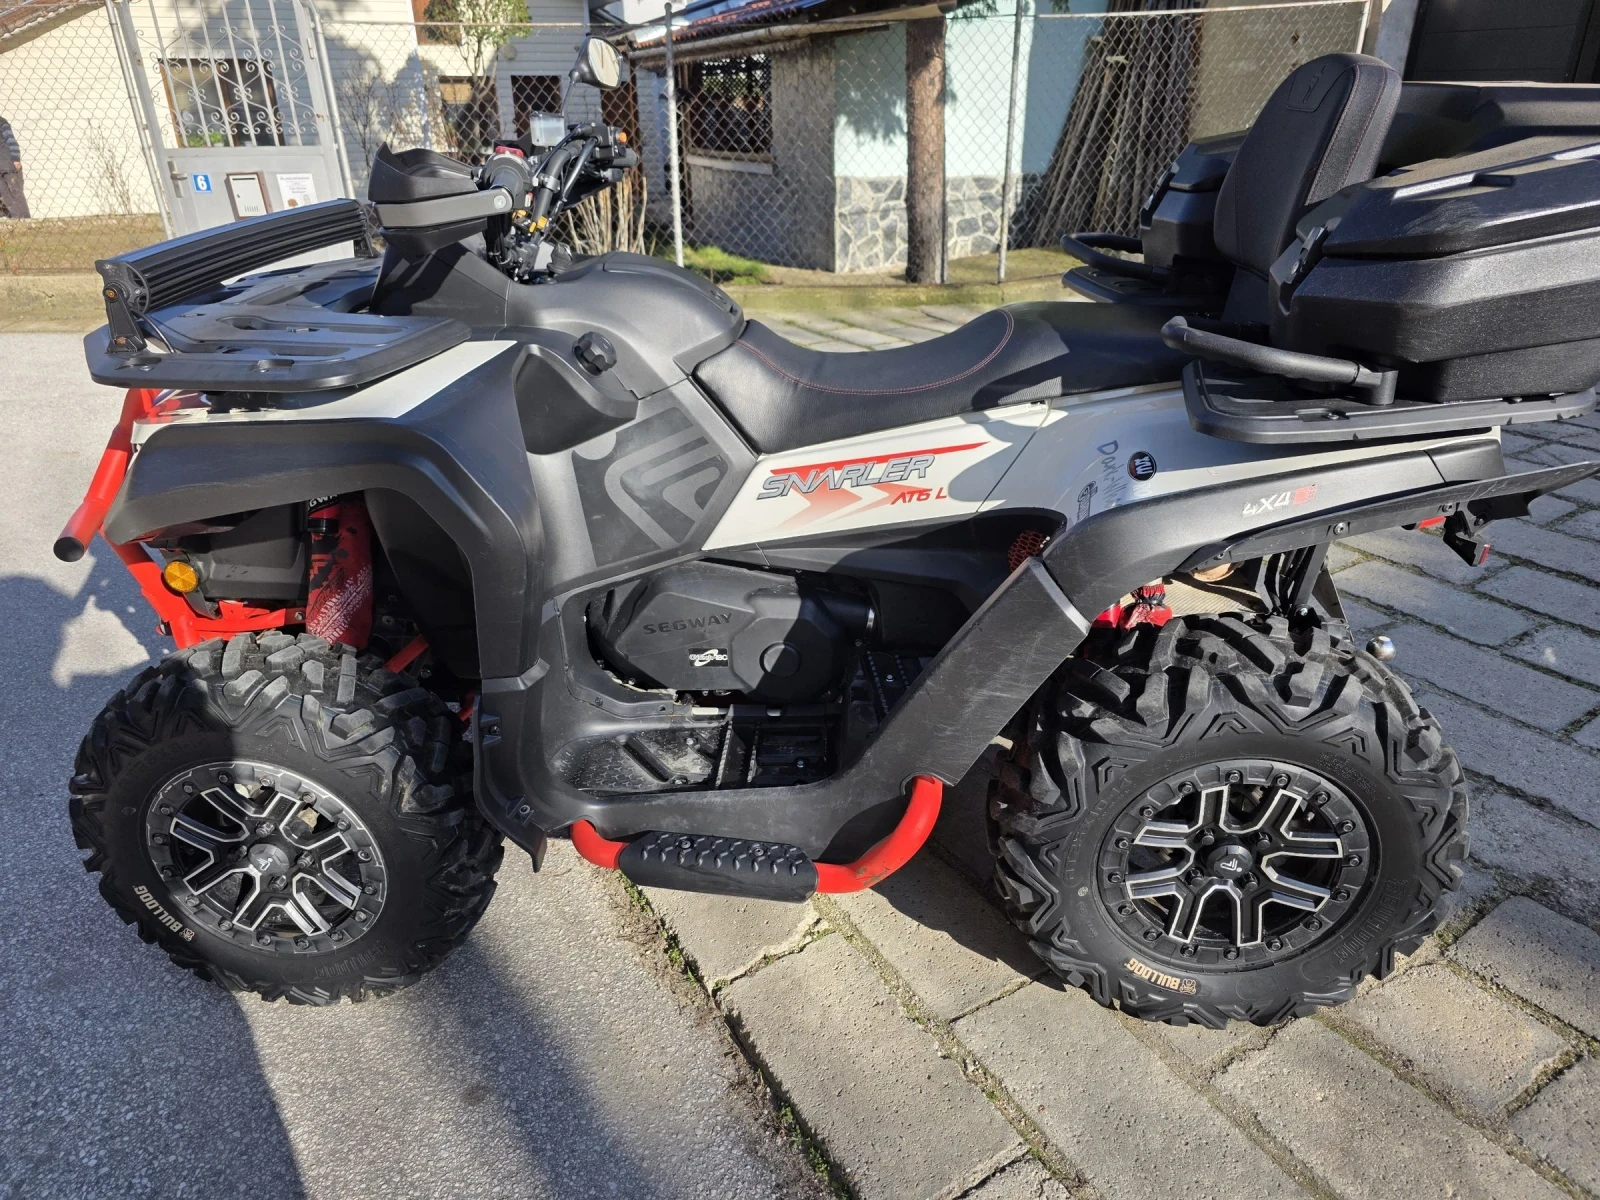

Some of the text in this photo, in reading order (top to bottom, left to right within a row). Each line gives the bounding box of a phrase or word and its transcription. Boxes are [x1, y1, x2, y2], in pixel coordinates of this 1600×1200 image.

[196, 175, 208, 191] 6
[756, 455, 935, 500] SNARLER
[890, 487, 947, 505] AT6 L
[643, 613, 732, 634] SEGWAY
[133, 885, 183, 932] BULLDOG
[1125, 957, 1181, 991] BULLDOG
